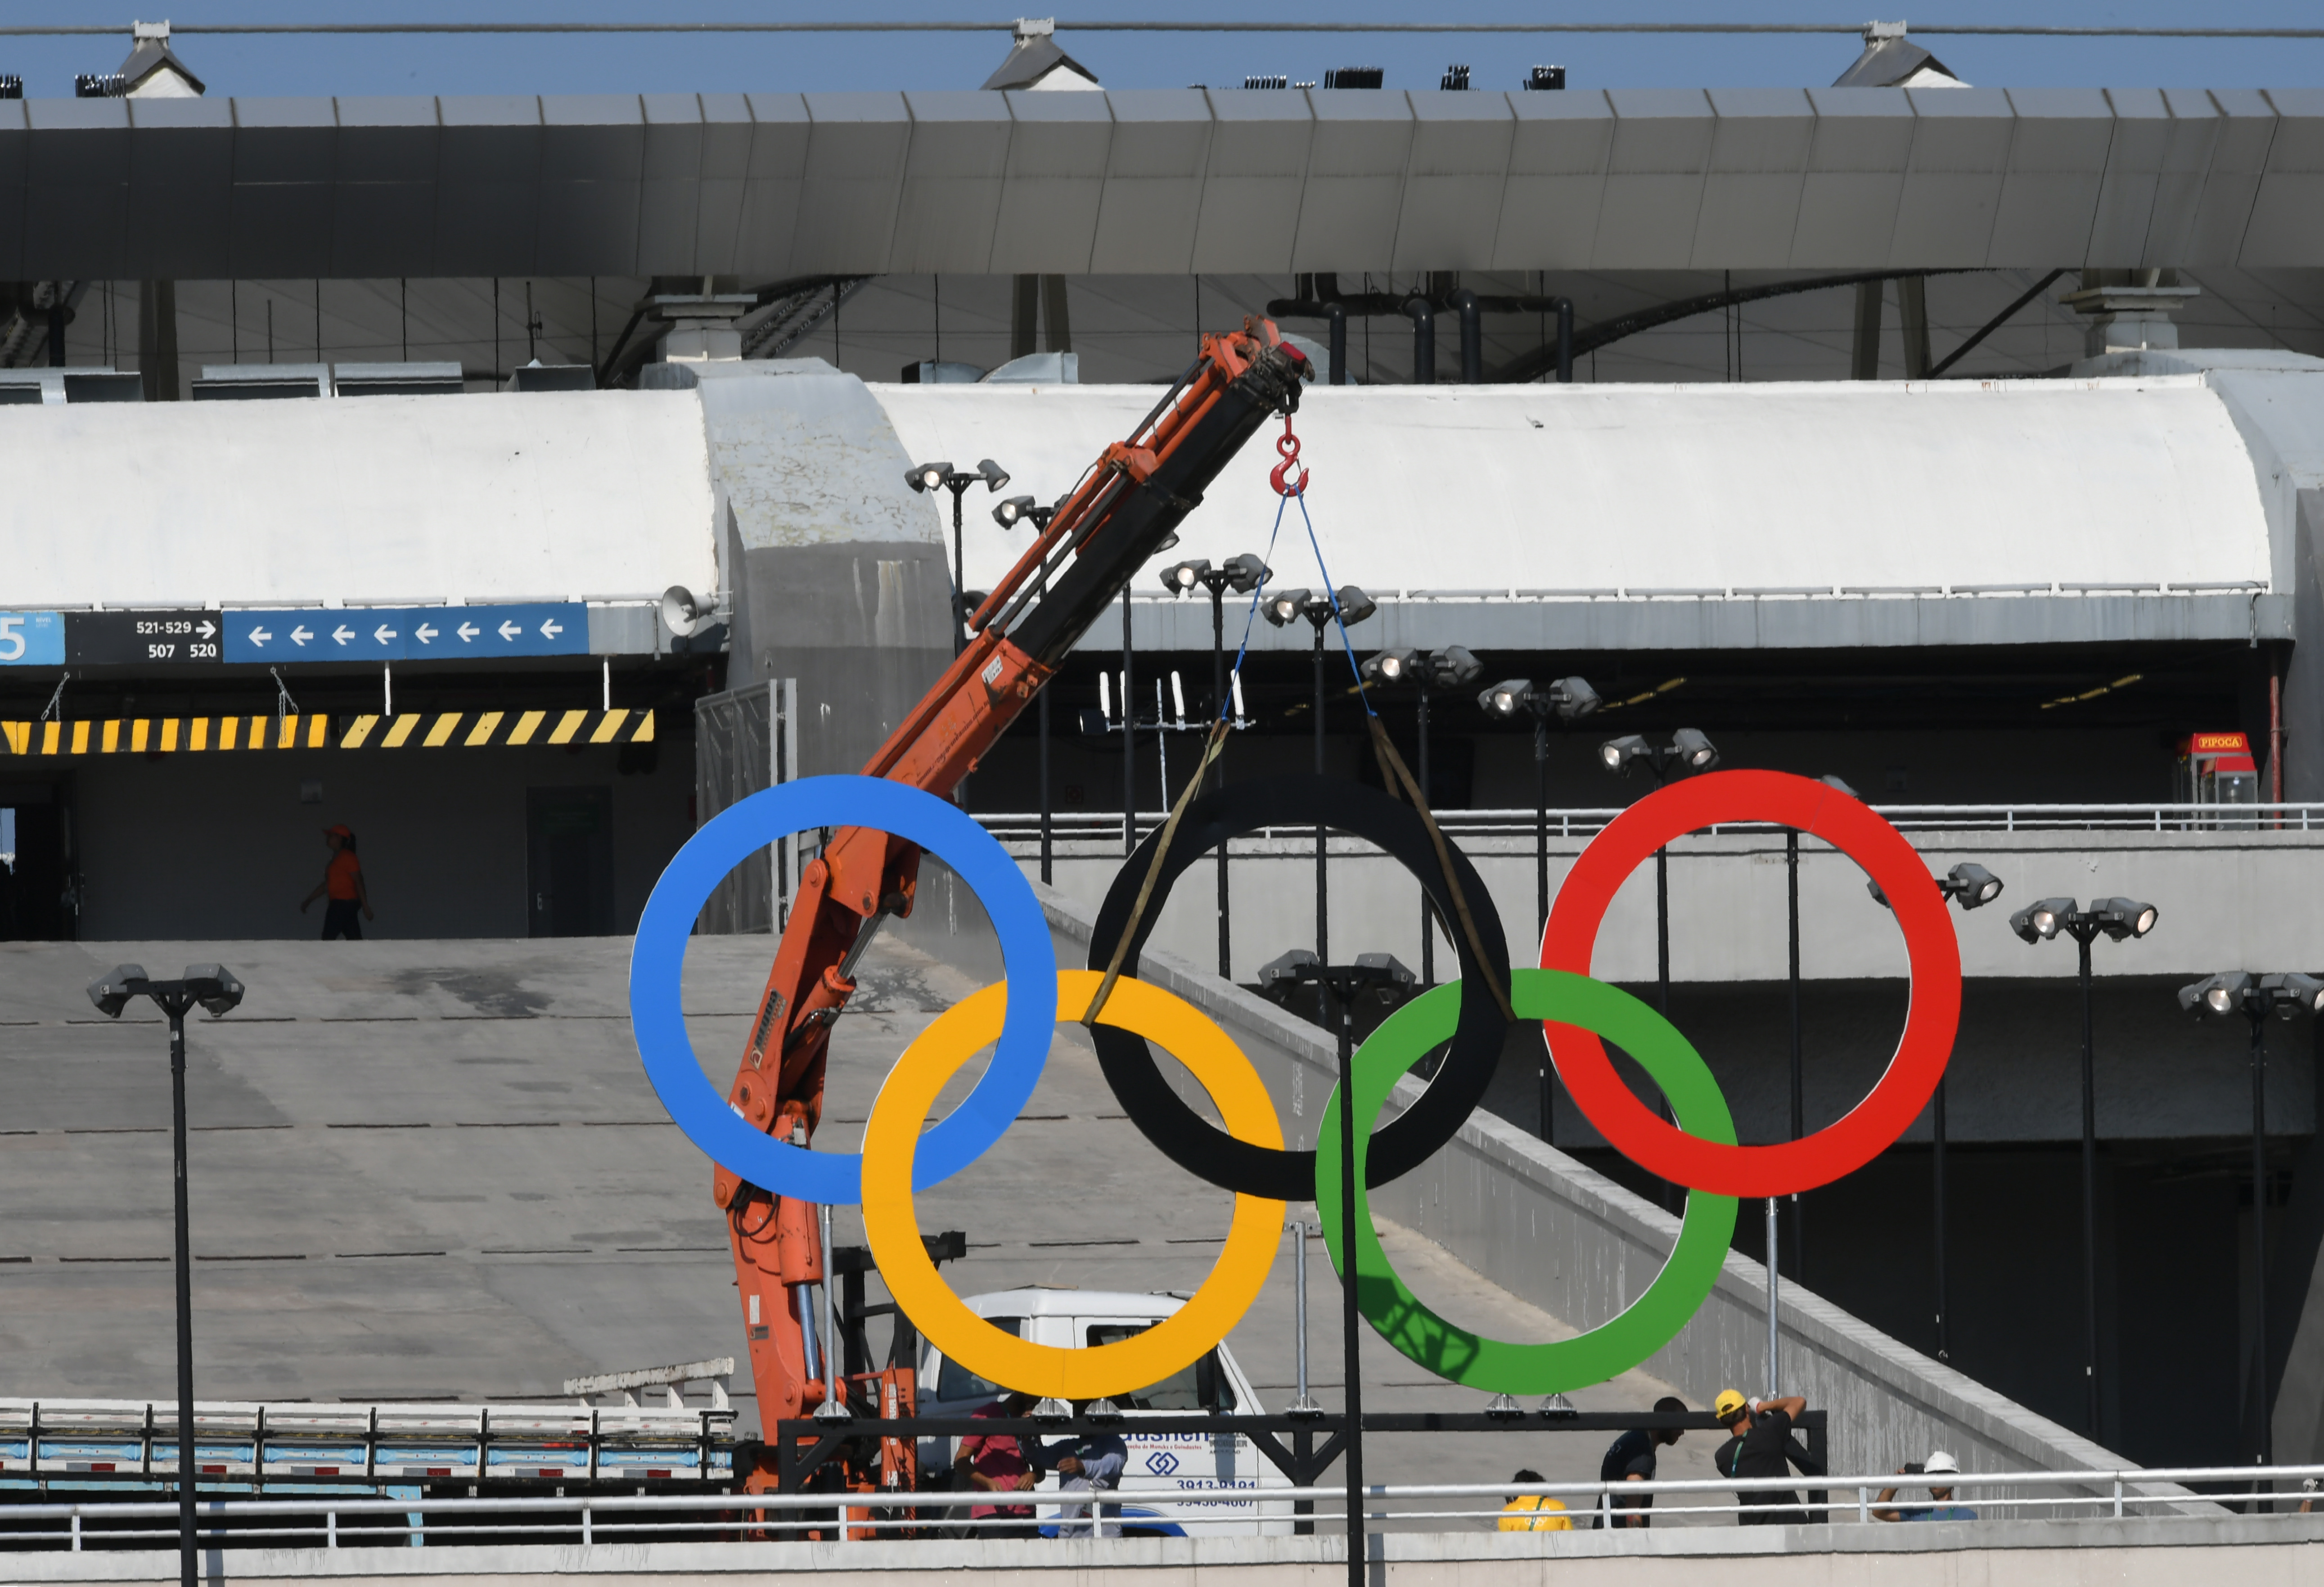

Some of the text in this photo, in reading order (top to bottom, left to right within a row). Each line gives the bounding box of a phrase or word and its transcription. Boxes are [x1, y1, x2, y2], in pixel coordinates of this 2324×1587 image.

[136, 622, 191, 634] 521-529
[0, 618, 25, 661] 5
[149, 644, 216, 658] 507 520
[2202, 738, 2239, 747] PIPOCA
